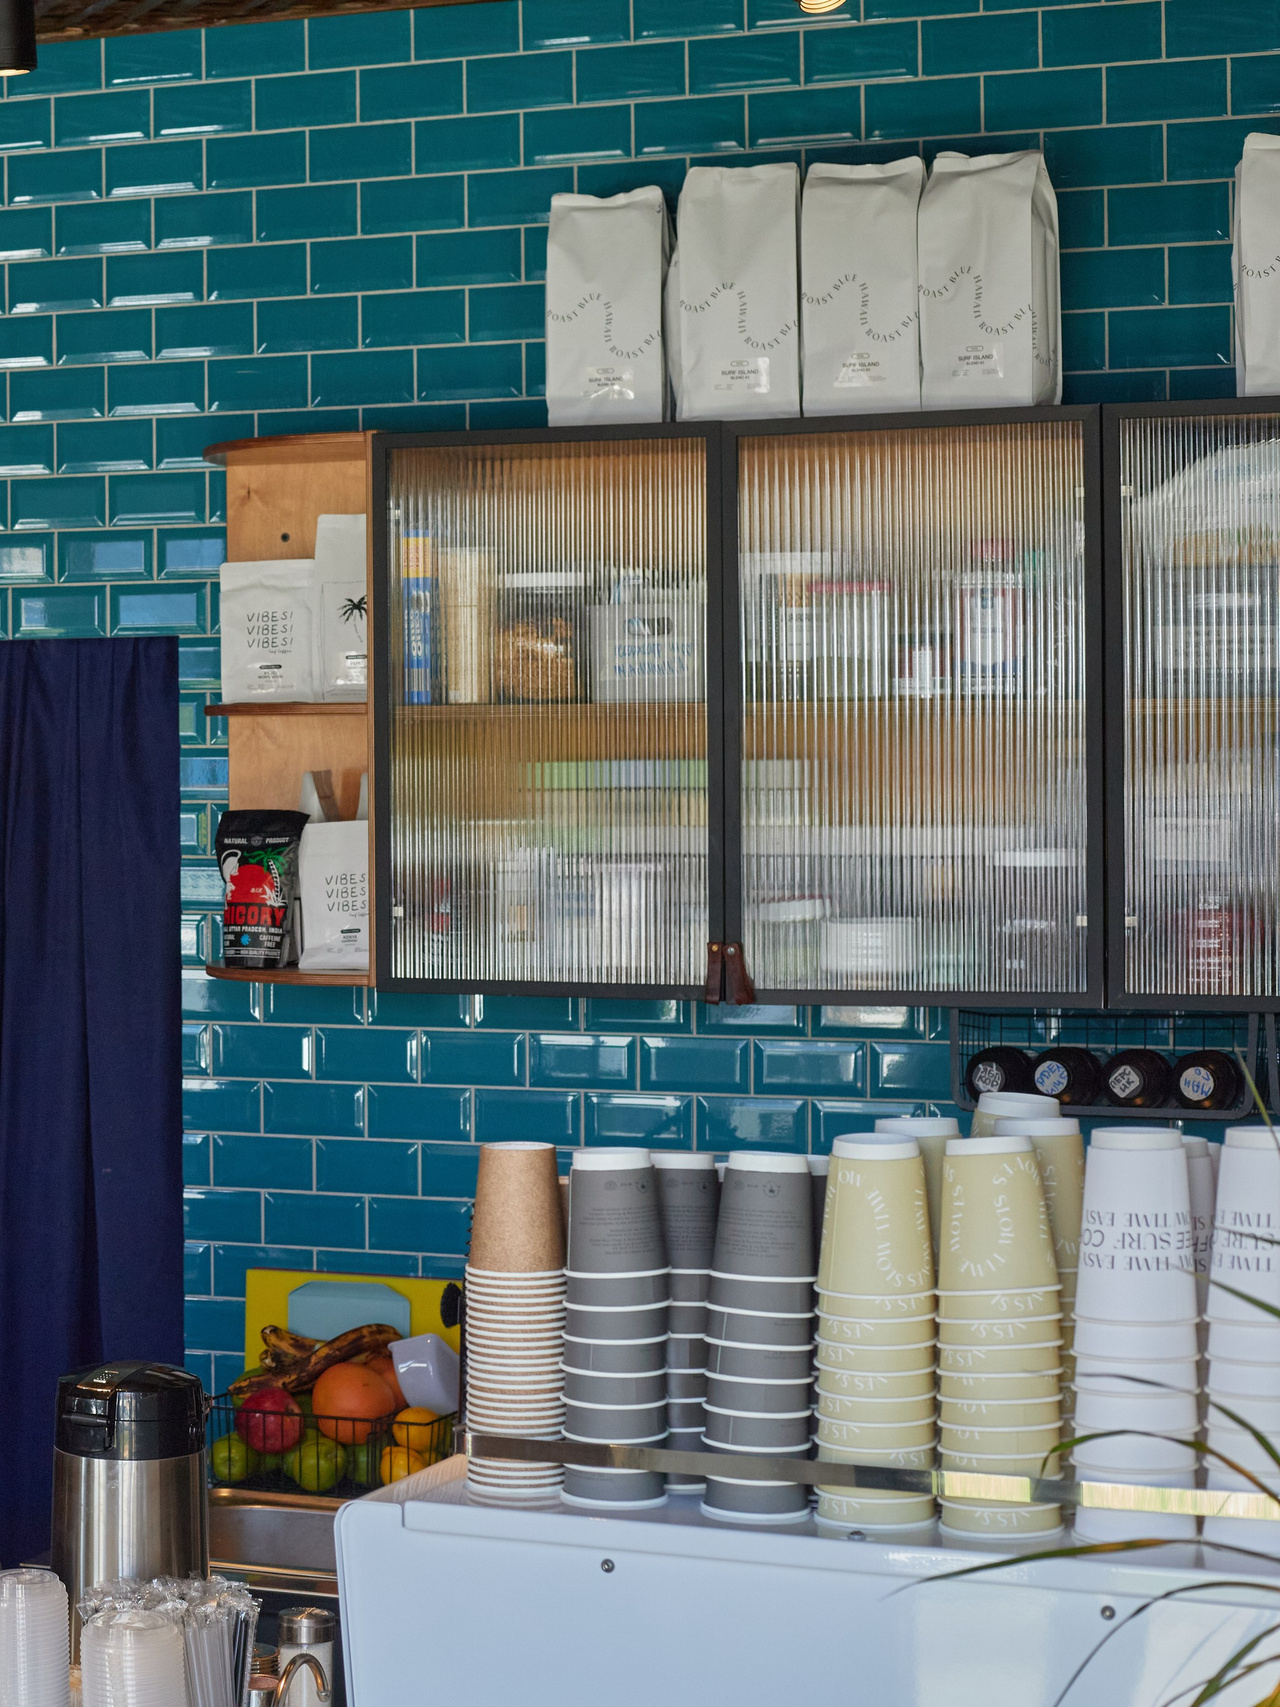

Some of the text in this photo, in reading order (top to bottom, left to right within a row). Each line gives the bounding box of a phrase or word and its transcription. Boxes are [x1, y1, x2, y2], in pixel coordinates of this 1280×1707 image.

[1241, 263, 1276, 280] ROAST
[833, 274, 858, 291] BLUE
[859, 282, 869, 326] HAWAII
[865, 328, 902, 343] ROAST
[949, 265, 972, 284] BLUE
[973, 275, 983, 319] HAWAII
[979, 321, 1014, 336] ROAST
[679, 282, 781, 351] ROAST BLUE HAWAII ROAST
[577, 292, 602, 309] BLUE
[602, 301, 614, 343] HAWAII
[609, 345, 644, 360] ROAST
[246, 610, 294, 623] VIBES!
[246, 624, 294, 636] VIBES!
[246, 636, 294, 649] VIBES!
[223, 836, 290, 845] NATURAL PRODUCT
[1124, 1212, 1168, 1228] TIME
[1232, 1211, 1271, 1228] TIME
[1113, 1232, 1171, 1250] SURF
[1124, 1255, 1170, 1272] TIME
[1230, 1255, 1271, 1272] TIME
